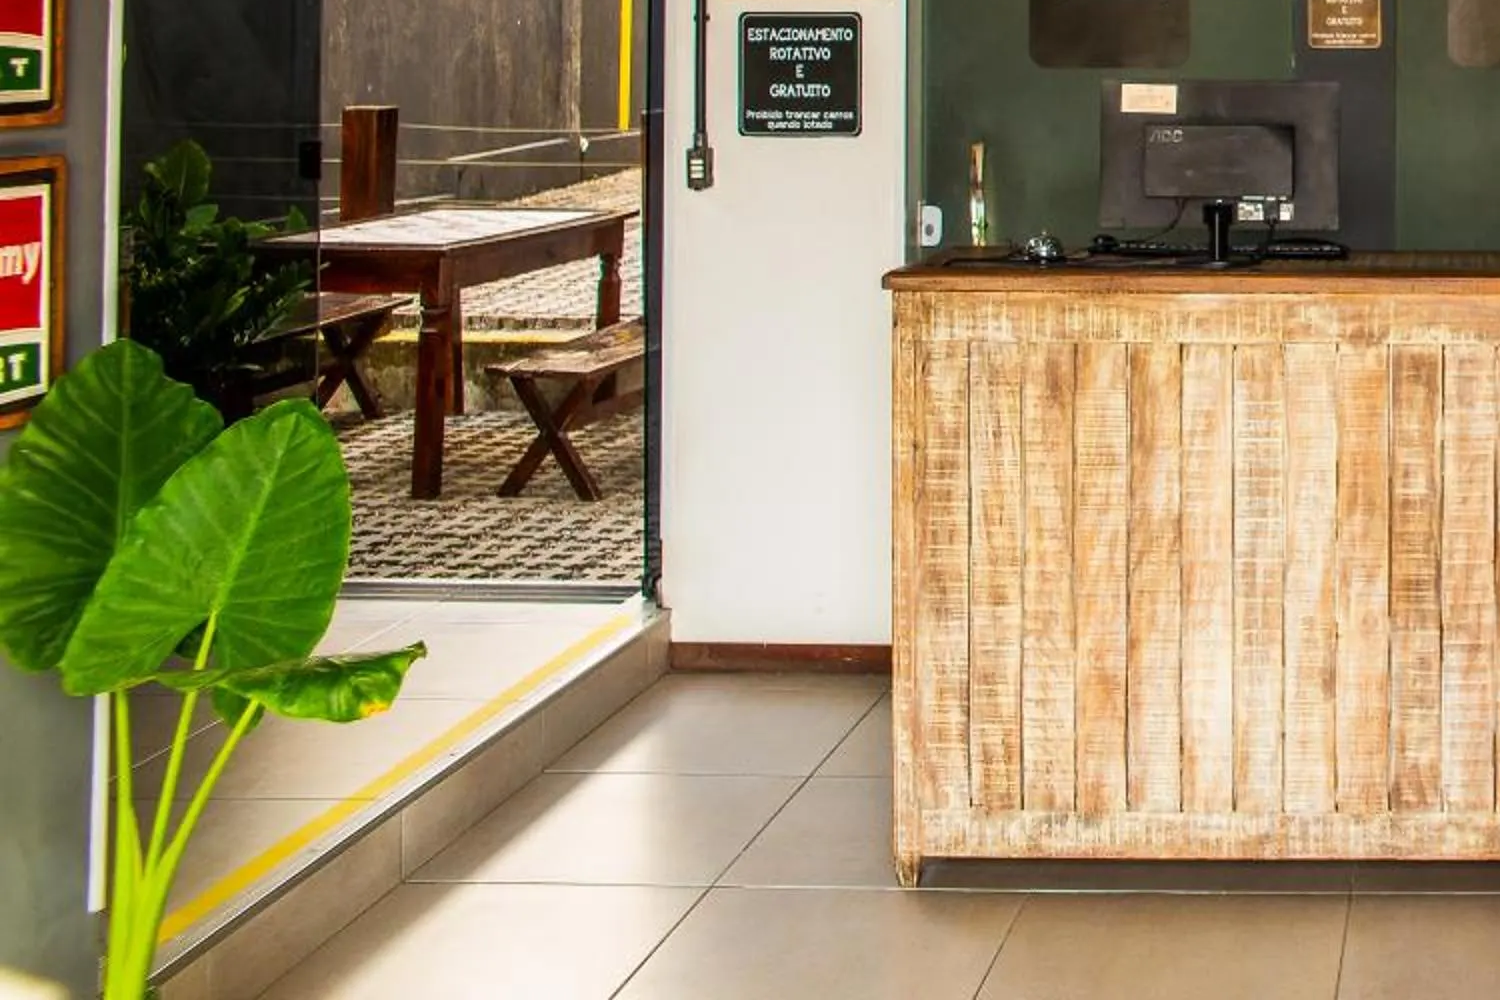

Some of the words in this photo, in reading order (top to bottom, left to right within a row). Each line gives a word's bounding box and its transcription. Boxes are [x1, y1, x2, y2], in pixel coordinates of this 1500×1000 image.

[747, 27, 853, 42] ESTACIONAMENTO
[769, 47, 831, 61] ROTATIVO
[795, 64, 805, 78] E
[769, 83, 831, 98] GRATUITO
